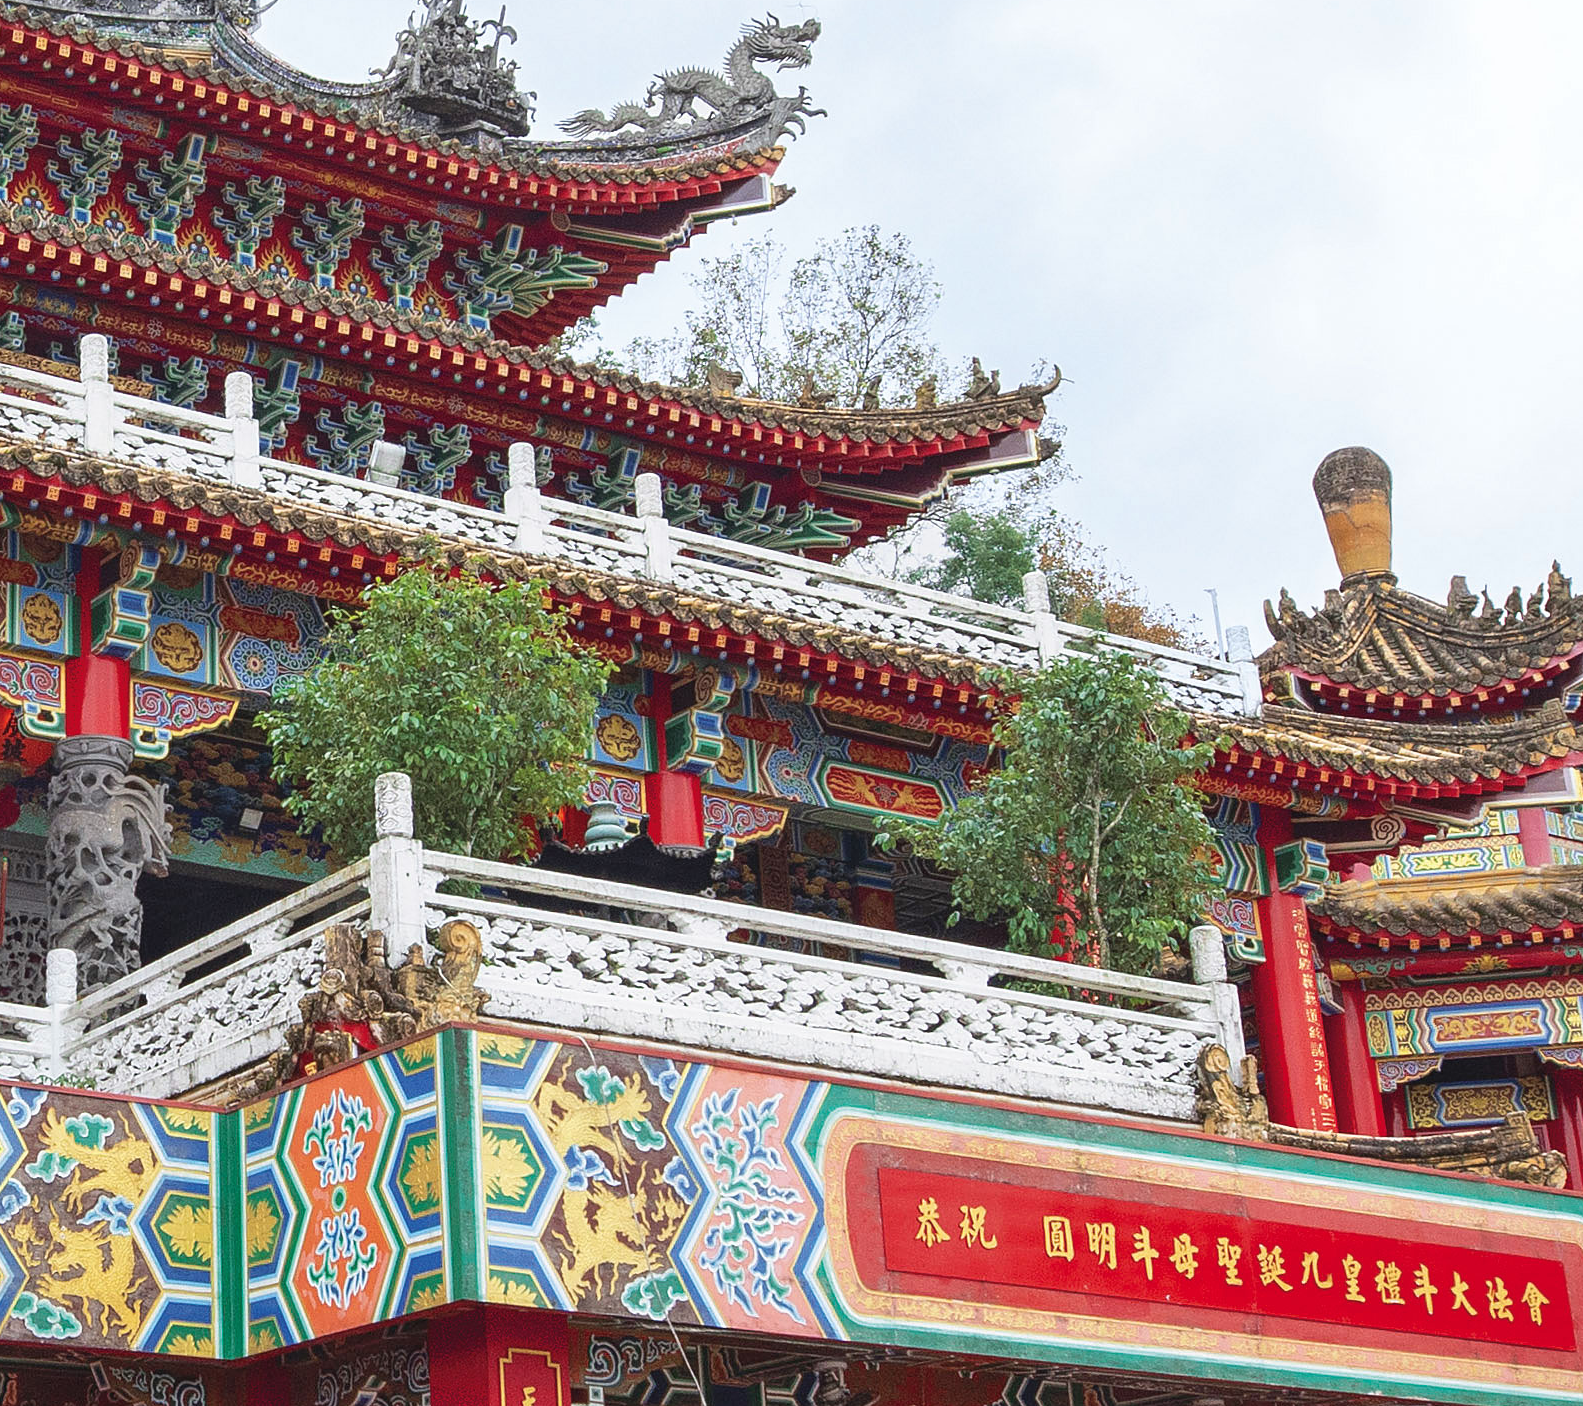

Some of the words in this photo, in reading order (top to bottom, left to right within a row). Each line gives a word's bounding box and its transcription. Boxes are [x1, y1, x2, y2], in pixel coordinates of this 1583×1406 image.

[916, 1197, 997, 1249] 恭祝
[1043, 1216, 1550, 1326] 圓明斗母聖誕九皇禮斗大法會
